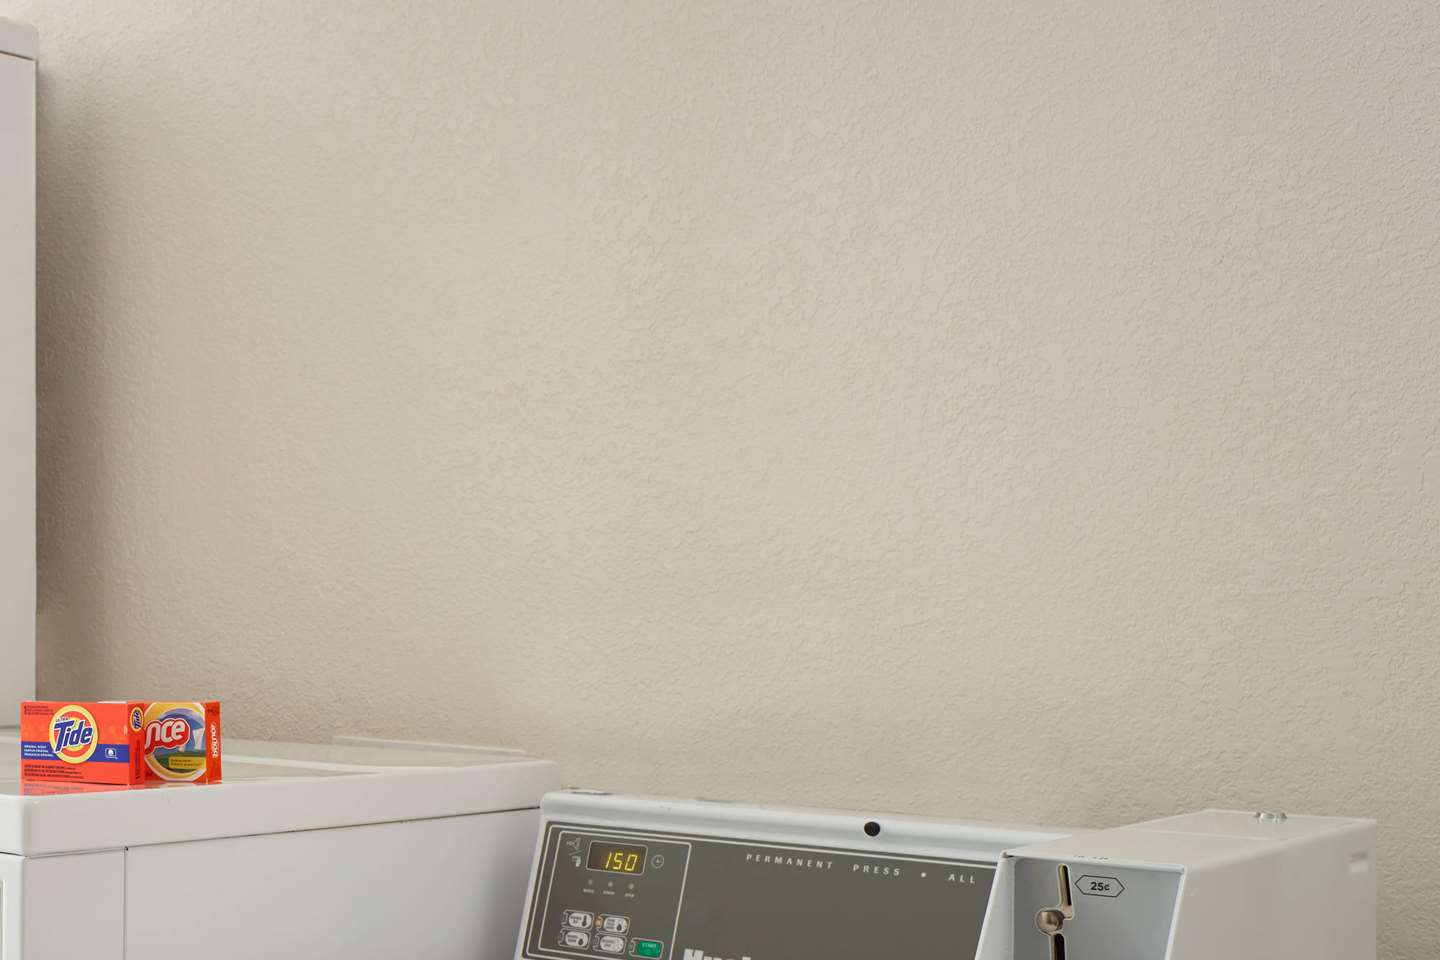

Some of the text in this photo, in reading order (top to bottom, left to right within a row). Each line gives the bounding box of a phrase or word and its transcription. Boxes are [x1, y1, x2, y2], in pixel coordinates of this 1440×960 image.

[133, 709, 141, 730] Tide
[53, 719, 93, 753] Tide
[605, 852, 638, 872] 150
[745, 853, 977, 885] PERMANENT PRESS ALL
[1090, 881, 1110, 891] 25¢
